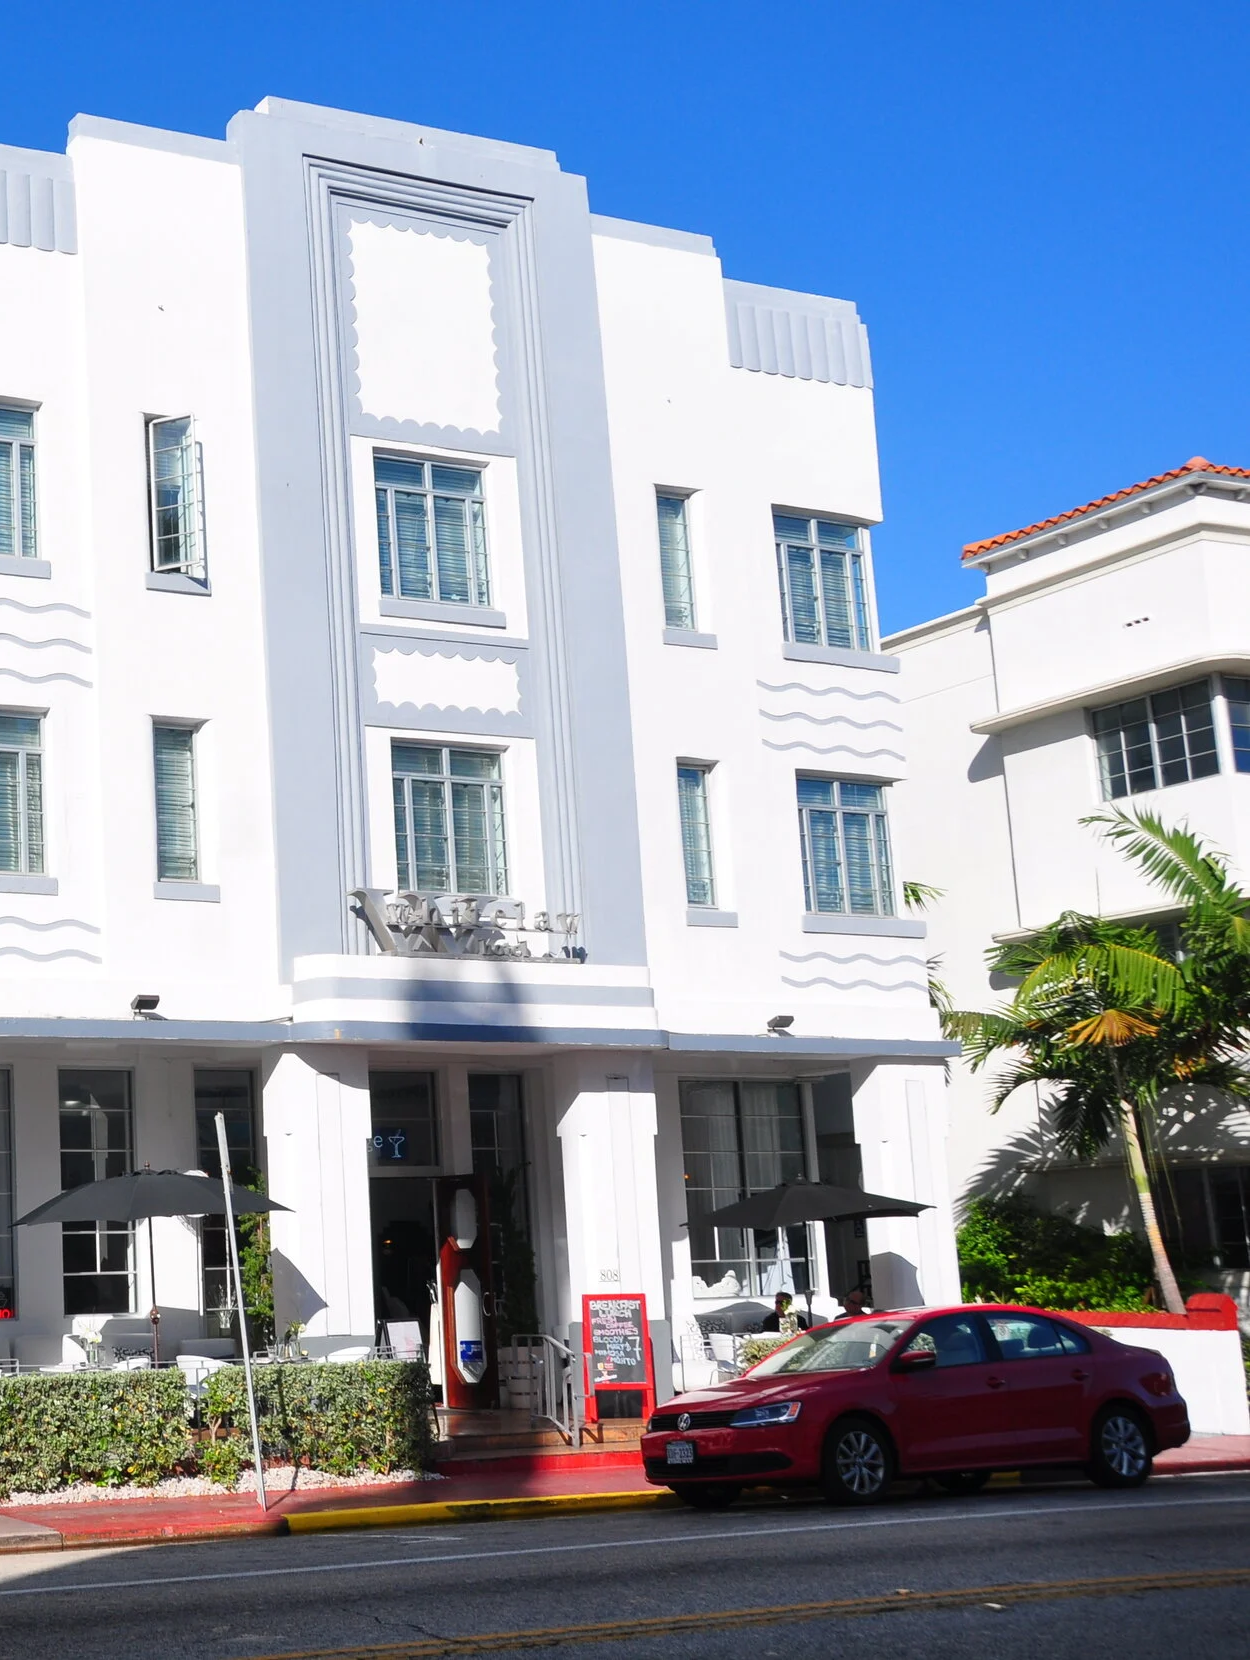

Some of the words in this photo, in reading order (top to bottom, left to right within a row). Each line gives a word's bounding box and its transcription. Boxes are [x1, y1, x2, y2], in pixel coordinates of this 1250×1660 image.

[599, 1268, 618, 1282] 808
[598, 1310, 632, 1318] LUNCH
[592, 1335, 624, 1344] BLOODY
